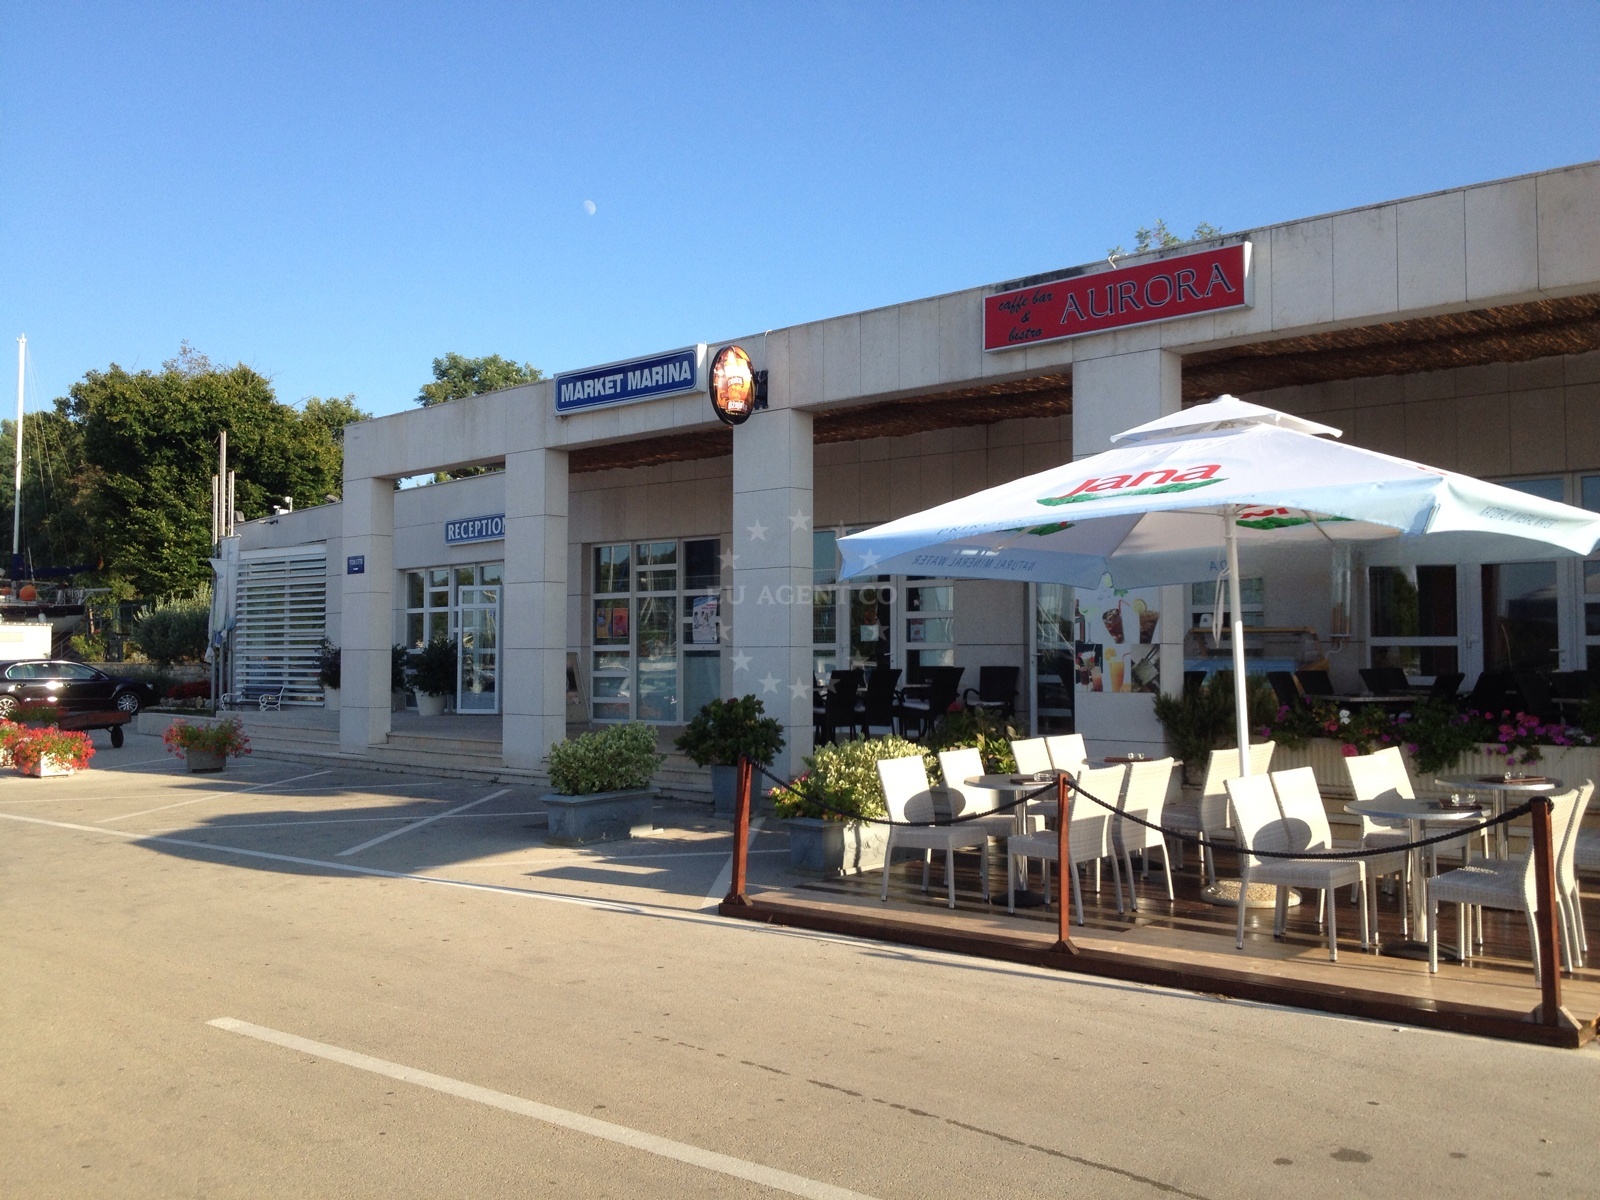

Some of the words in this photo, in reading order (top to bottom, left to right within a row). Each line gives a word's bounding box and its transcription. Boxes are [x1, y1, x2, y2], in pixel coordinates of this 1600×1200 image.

[998, 292, 1028, 314] caffe
[1032, 288, 1053, 304] bar
[1060, 263, 1235, 324] AURORA
[1020, 310, 1031, 323] &
[1008, 326, 1043, 342] bistro
[560, 373, 624, 403] MARKET
[627, 360, 692, 390] MARINA
